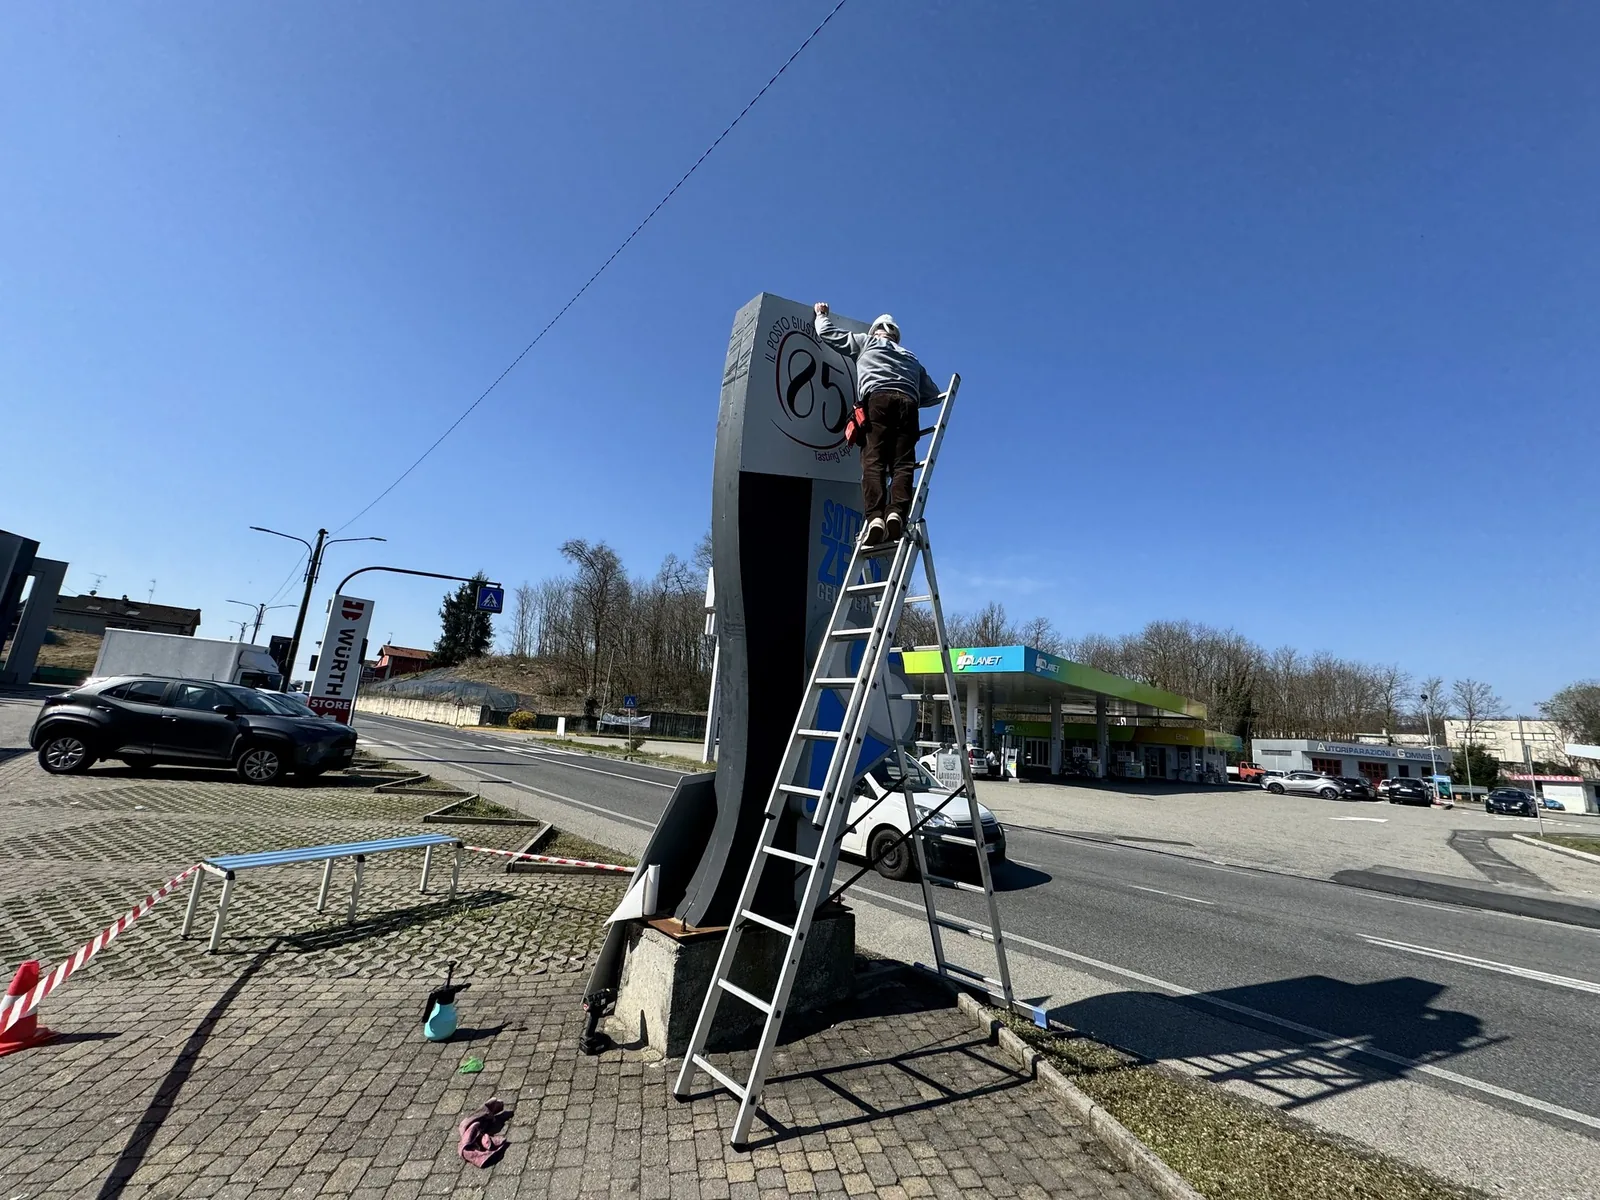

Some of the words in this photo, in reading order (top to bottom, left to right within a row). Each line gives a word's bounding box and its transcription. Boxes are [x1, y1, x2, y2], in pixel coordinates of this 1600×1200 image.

[767, 316, 791, 351] POSTO
[765, 352, 776, 364] IL
[786, 348, 848, 434] 85
[813, 450, 840, 464] Tasting
[821, 499, 864, 546] SOTT
[325, 628, 356, 696] WÜRTH
[310, 699, 350, 710] STORE
[1317, 742, 1391, 757] AUTORIPARAZIONI
[1397, 748, 1443, 761] GOMMISTA
